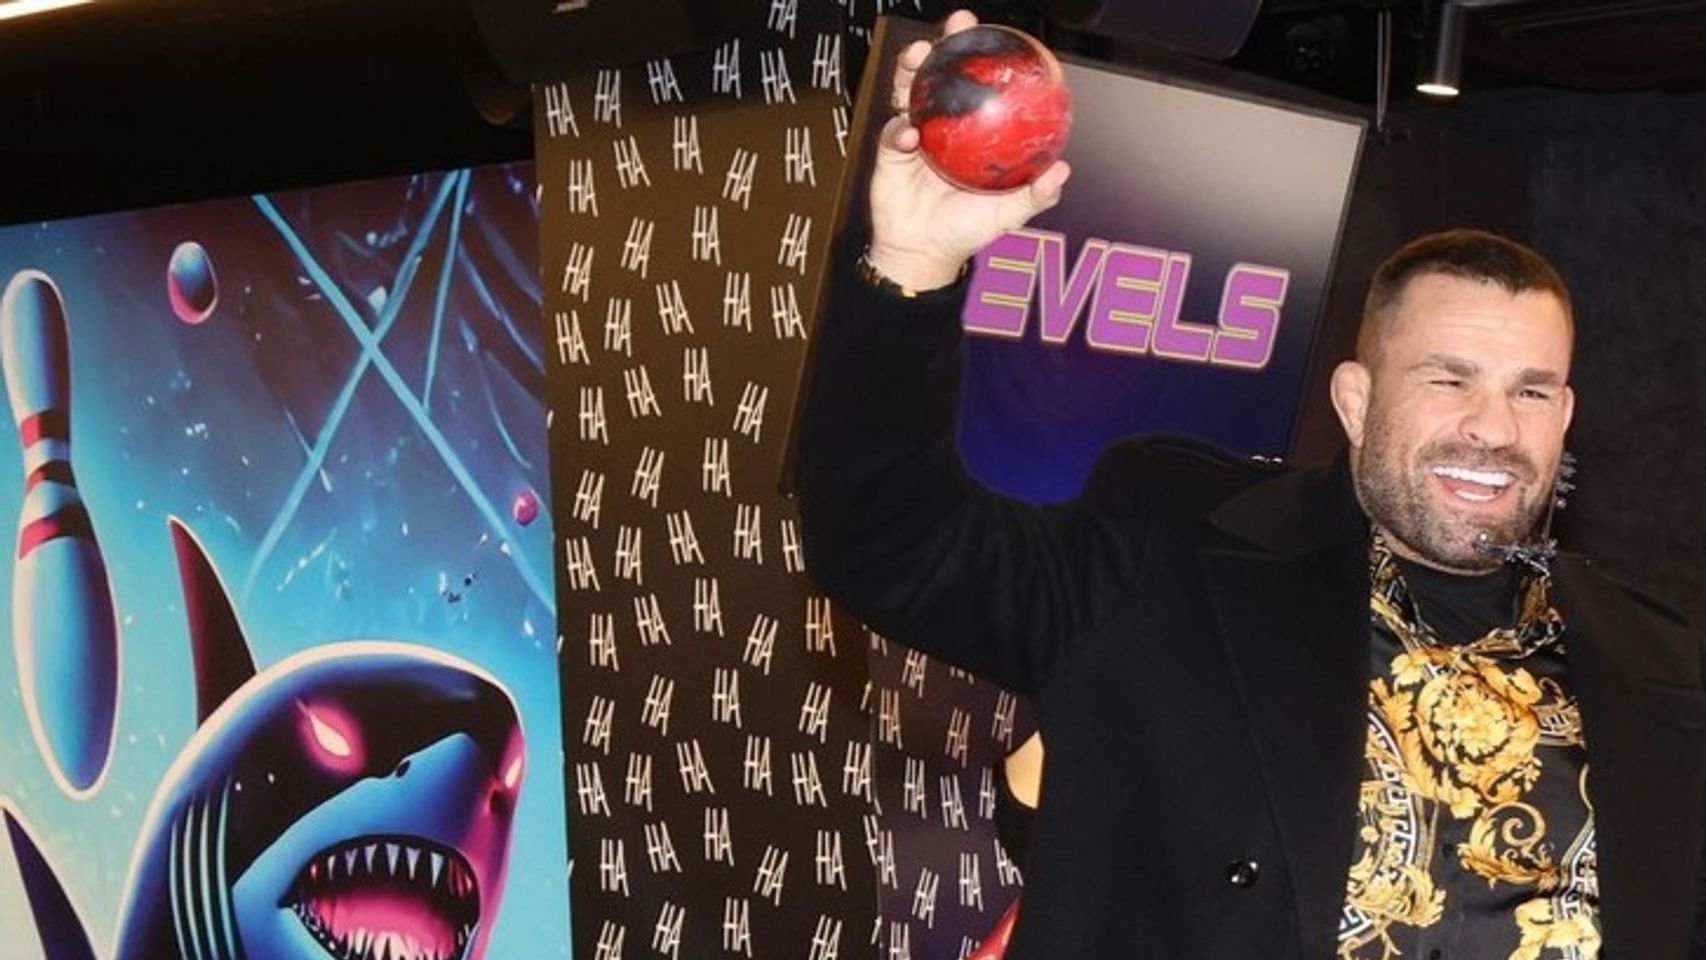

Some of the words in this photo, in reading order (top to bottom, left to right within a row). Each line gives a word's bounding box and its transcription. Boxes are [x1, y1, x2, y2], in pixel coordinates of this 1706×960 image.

[646, 58, 684, 105] HA
[712, 37, 742, 99] HA
[759, 46, 797, 105] HA
[810, 32, 842, 96] HA
[544, 82, 580, 138] HA
[612, 134, 652, 190] HA
[671, 114, 704, 175] HA
[783, 125, 817, 188] HA
[567, 158, 599, 218] HA
[721, 147, 759, 211] HA
[561, 241, 595, 303] HA
[620, 216, 655, 280] HA
[777, 212, 813, 276] HA
[603, 296, 633, 359] HA
[655, 279, 695, 336] HA
[722, 270, 753, 333] HA
[962, 229, 1290, 370] EVELS
[554, 309, 591, 366] HA
[623, 364, 663, 419] HA
[682, 346, 715, 407] HA
[577, 385, 610, 446] HA
[732, 380, 769, 445] HA
[572, 468, 606, 530] HA
[630, 445, 665, 509] HA
[565, 535, 601, 592] HA
[613, 524, 643, 587] HA
[665, 509, 706, 566] HA
[732, 502, 764, 566] HA
[588, 612, 620, 672] HA
[633, 592, 672, 647] HA
[742, 612, 780, 676] HA
[804, 596, 837, 658] HA
[711, 667, 743, 730] HA
[901, 648, 928, 699] HA
[640, 673, 675, 737] HA
[797, 681, 833, 745] HA
[878, 687, 903, 751] HA
[991, 689, 1017, 751] HA
[675, 737, 716, 795] HA
[742, 733, 774, 798] HA
[944, 707, 971, 768] HA
[575, 760, 612, 819] HA
[624, 751, 653, 814] HA
[790, 749, 829, 808] HA
[841, 739, 874, 805] HA
[903, 755, 928, 820] HA
[939, 773, 970, 832] HA
[598, 837, 631, 899] HA
[702, 806, 735, 868] HA
[814, 829, 848, 892] HA
[752, 844, 789, 907] HA
[911, 867, 940, 930] HA
[958, 852, 984, 913] HA
[721, 896, 754, 959] HA
